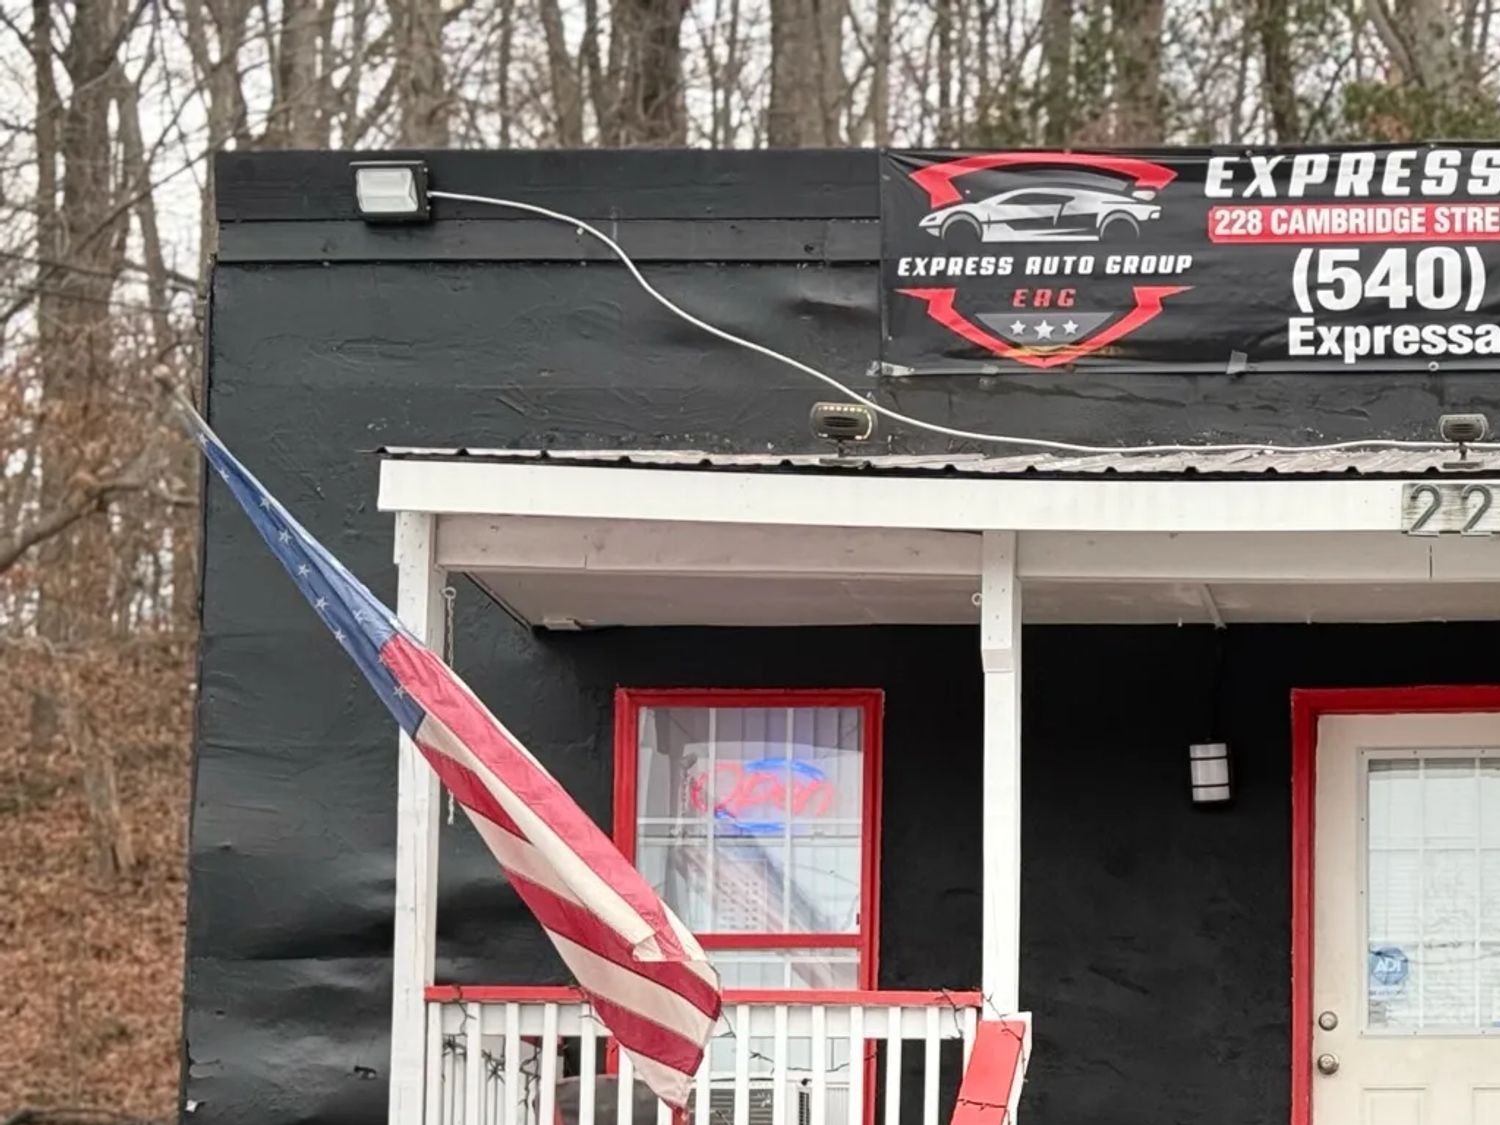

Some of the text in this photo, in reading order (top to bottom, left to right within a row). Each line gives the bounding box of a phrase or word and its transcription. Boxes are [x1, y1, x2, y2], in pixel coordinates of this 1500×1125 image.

[1214, 208, 1263, 236] 228
[1270, 207, 1426, 235] CAMBRIDGE
[897, 254, 1193, 277] EXPRESS AUTO GROUP
[1291, 245, 1487, 313] (540)
